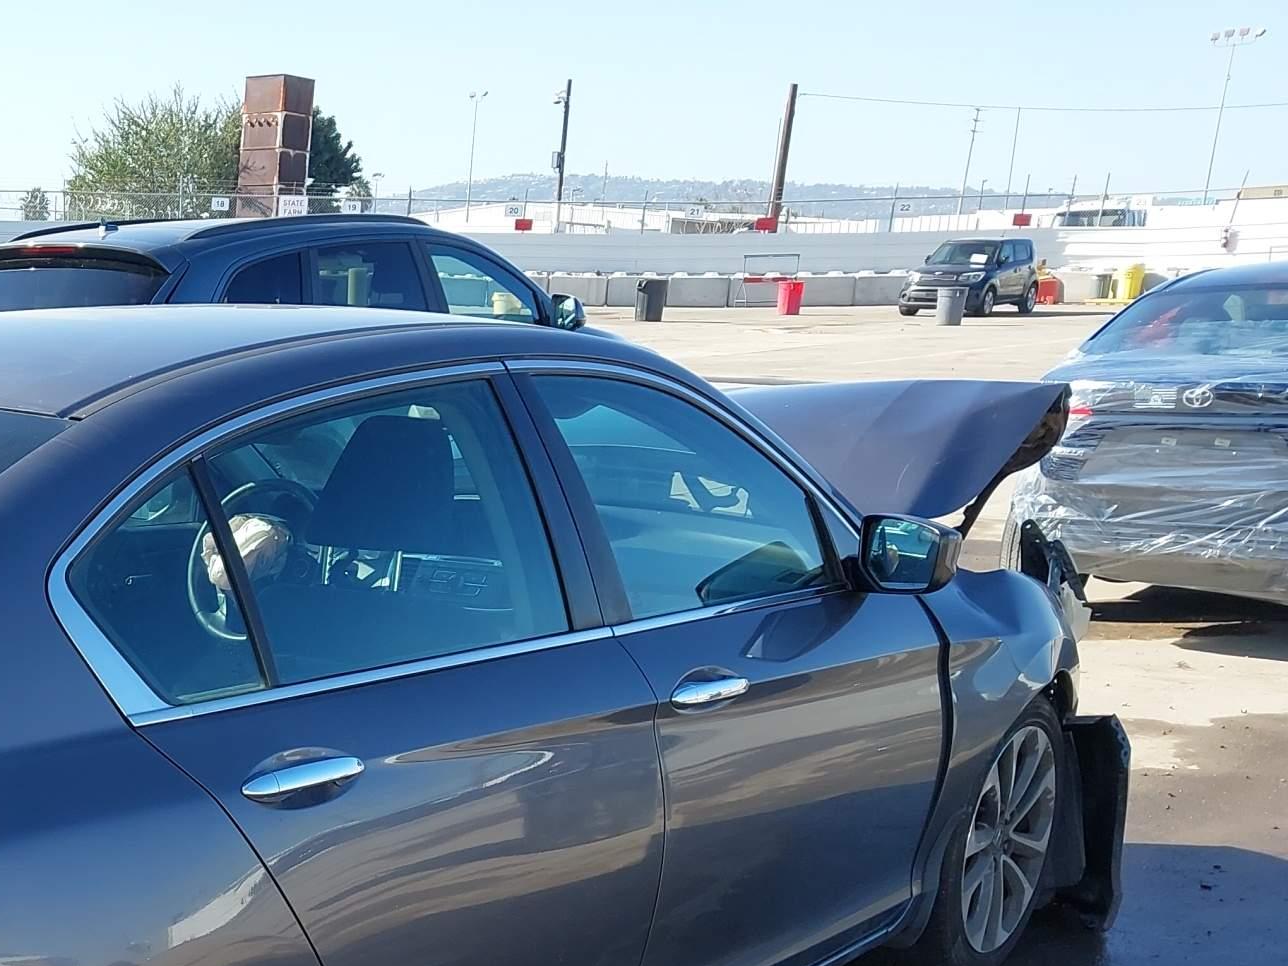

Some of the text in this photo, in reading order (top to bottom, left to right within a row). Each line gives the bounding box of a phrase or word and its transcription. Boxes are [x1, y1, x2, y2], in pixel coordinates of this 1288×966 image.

[215, 200, 226, 208] 18
[283, 199, 305, 207] STATE
[347, 204, 358, 212] 19
[508, 207, 519, 215] 20
[899, 203, 911, 212] 22
[689, 208, 700, 216] 21
